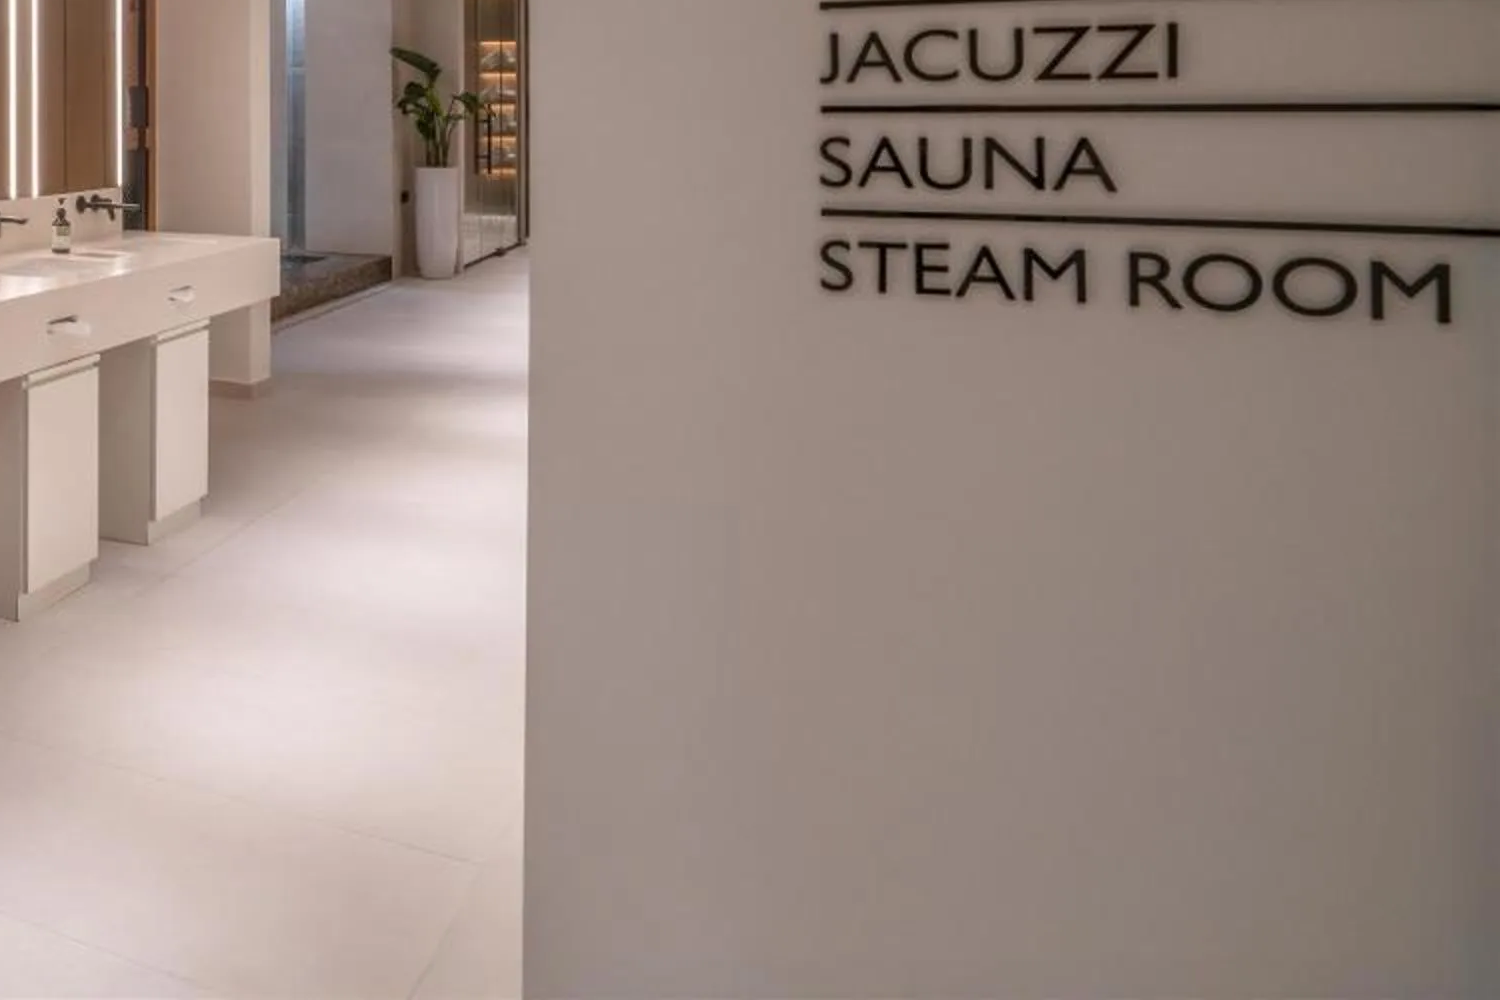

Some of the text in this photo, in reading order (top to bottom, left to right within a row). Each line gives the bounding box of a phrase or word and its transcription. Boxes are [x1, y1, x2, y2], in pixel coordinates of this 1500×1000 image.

[818, 21, 1180, 85] JACUZZI
[818, 135, 1119, 193] SAUNA
[818, 239, 1454, 326] STEAM ROOM
